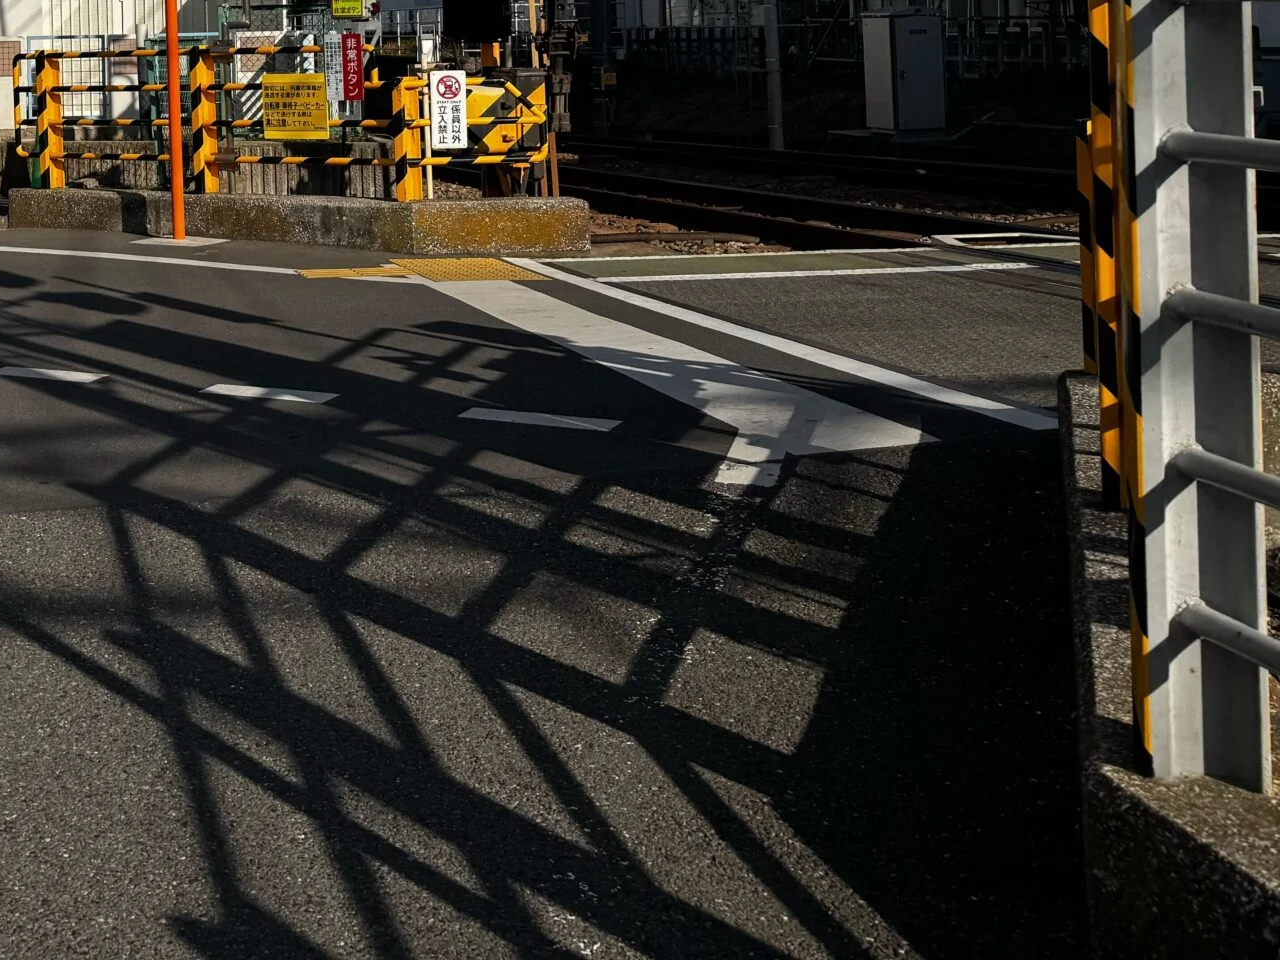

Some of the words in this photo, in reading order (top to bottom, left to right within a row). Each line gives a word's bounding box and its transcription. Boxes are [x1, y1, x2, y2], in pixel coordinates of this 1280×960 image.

[346, 38, 359, 96] 非常ボタン
[438, 105, 449, 144] 立入禁止
[451, 105, 462, 144] 係員以外
